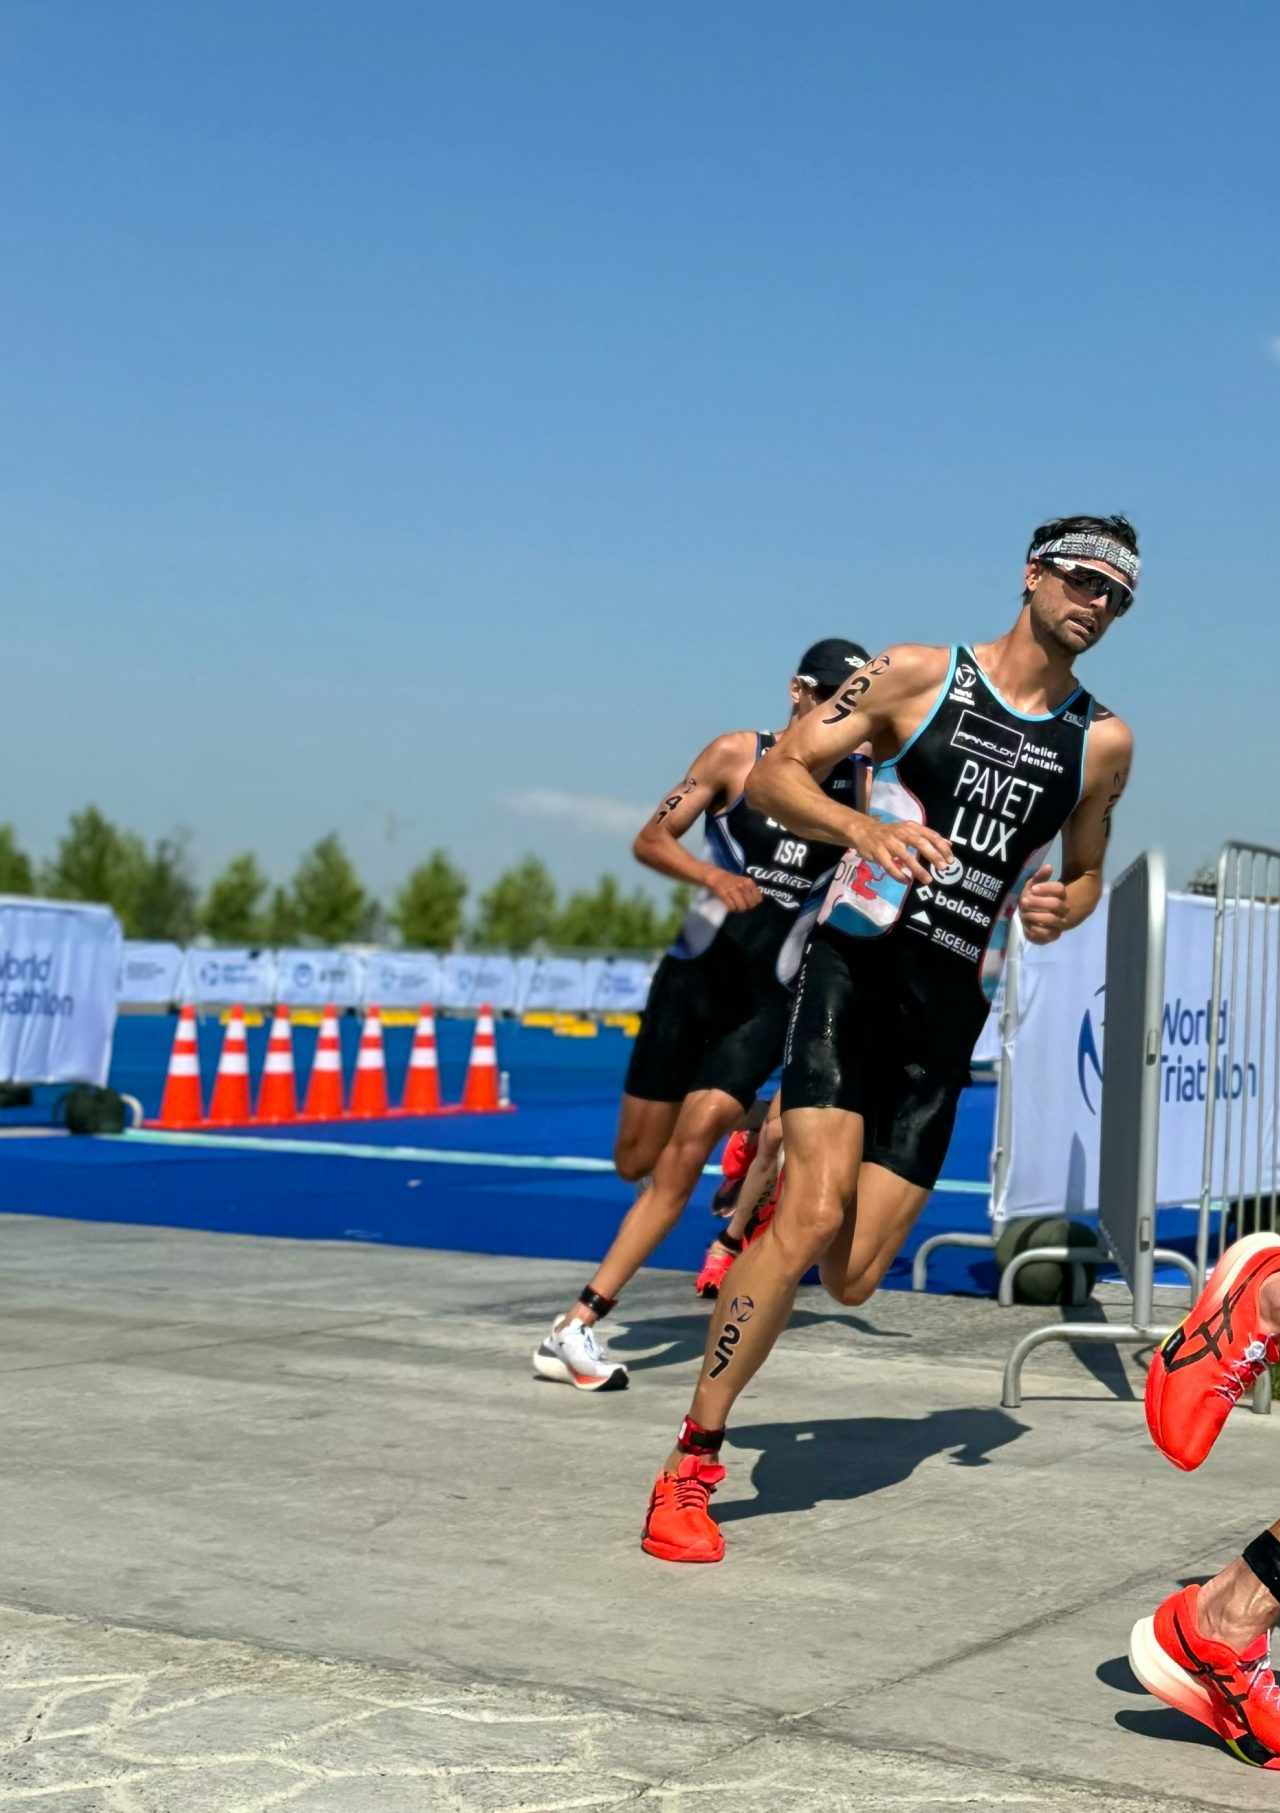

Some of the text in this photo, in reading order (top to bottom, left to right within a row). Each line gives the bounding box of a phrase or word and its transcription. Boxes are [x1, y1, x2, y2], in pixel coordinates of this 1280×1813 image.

[821, 676, 871, 725] 27
[1021, 753, 1064, 774] dentaire
[1023, 742, 1058, 760] Atelier
[953, 759, 1044, 824] PAYET
[949, 806, 1018, 862] LUX
[774, 839, 807, 867] ISR
[757, 885, 794, 902] aucony
[965, 866, 1004, 893] LOTERIE
[934, 890, 991, 927] baloise
[932, 928, 981, 960] SIGELUX
[708, 1323, 741, 1379] 27
